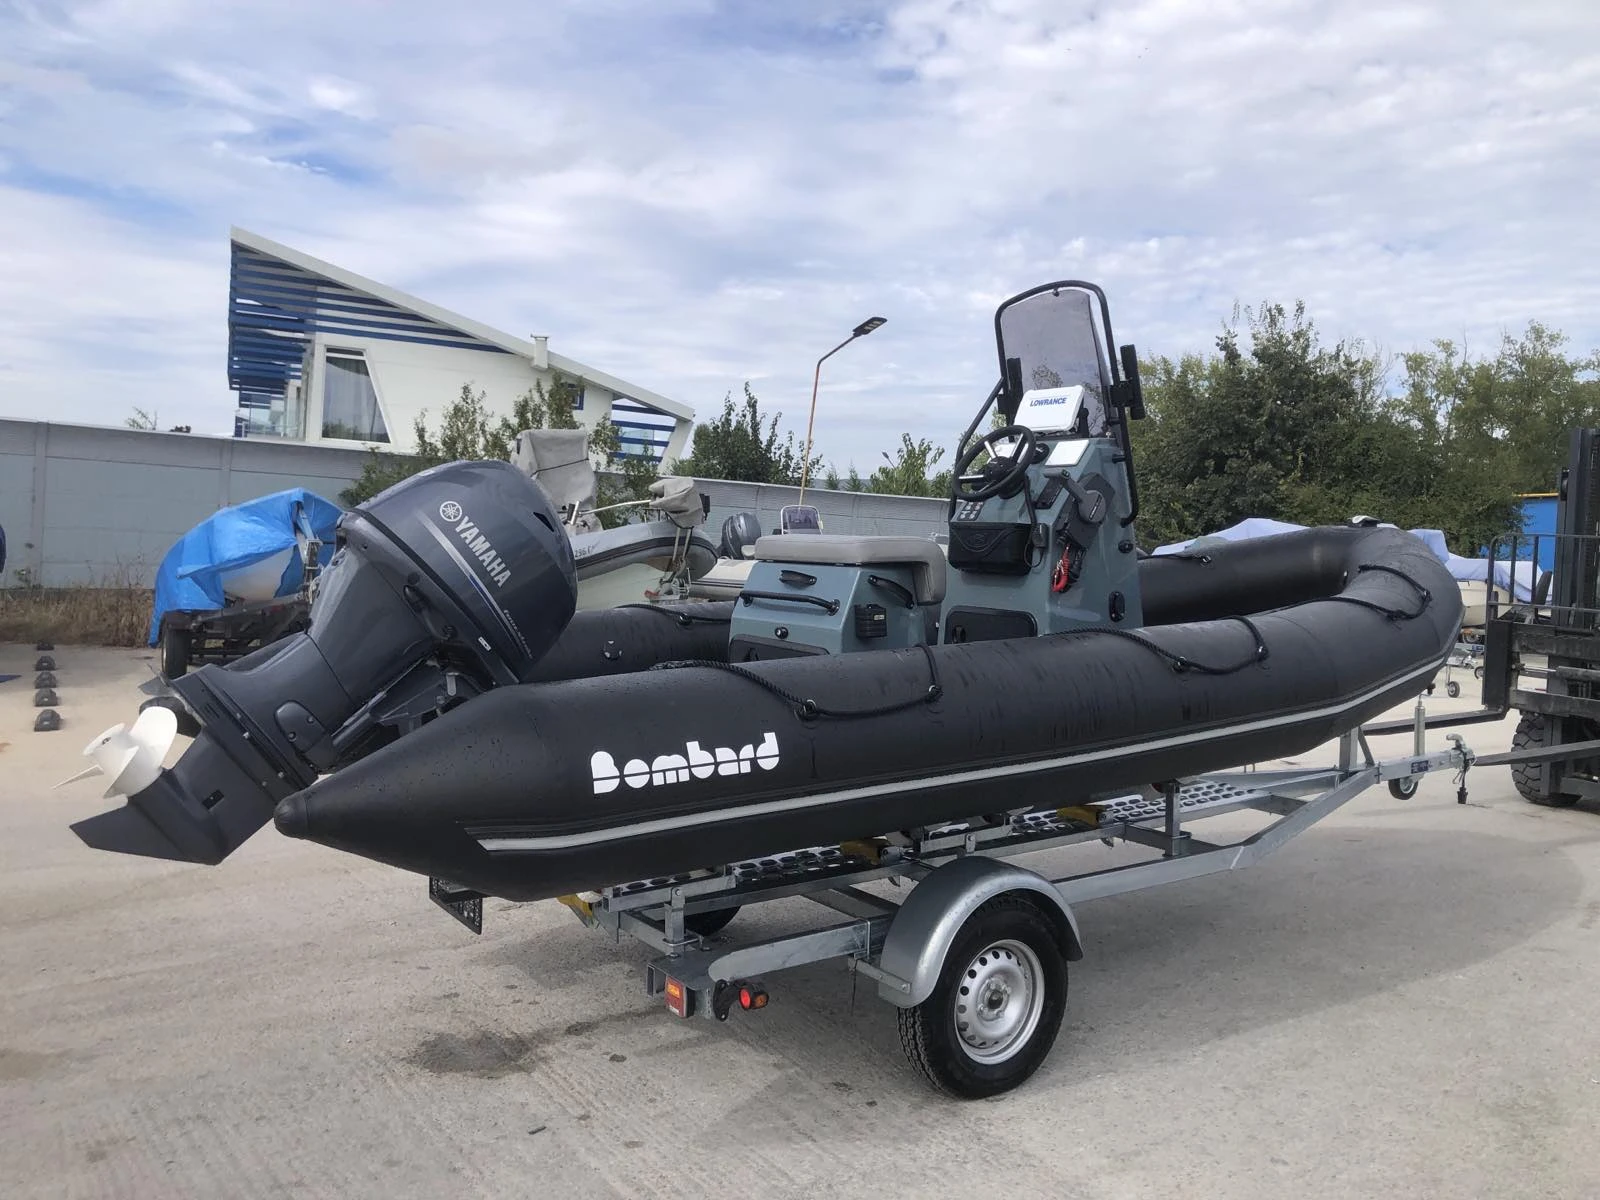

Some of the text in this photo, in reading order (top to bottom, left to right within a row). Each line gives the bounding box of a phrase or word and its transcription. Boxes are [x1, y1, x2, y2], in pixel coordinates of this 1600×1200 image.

[1030, 397, 1067, 407] LOWRANCE
[455, 515, 511, 587] YAMAHA
[590, 731, 780, 795] Bombard
